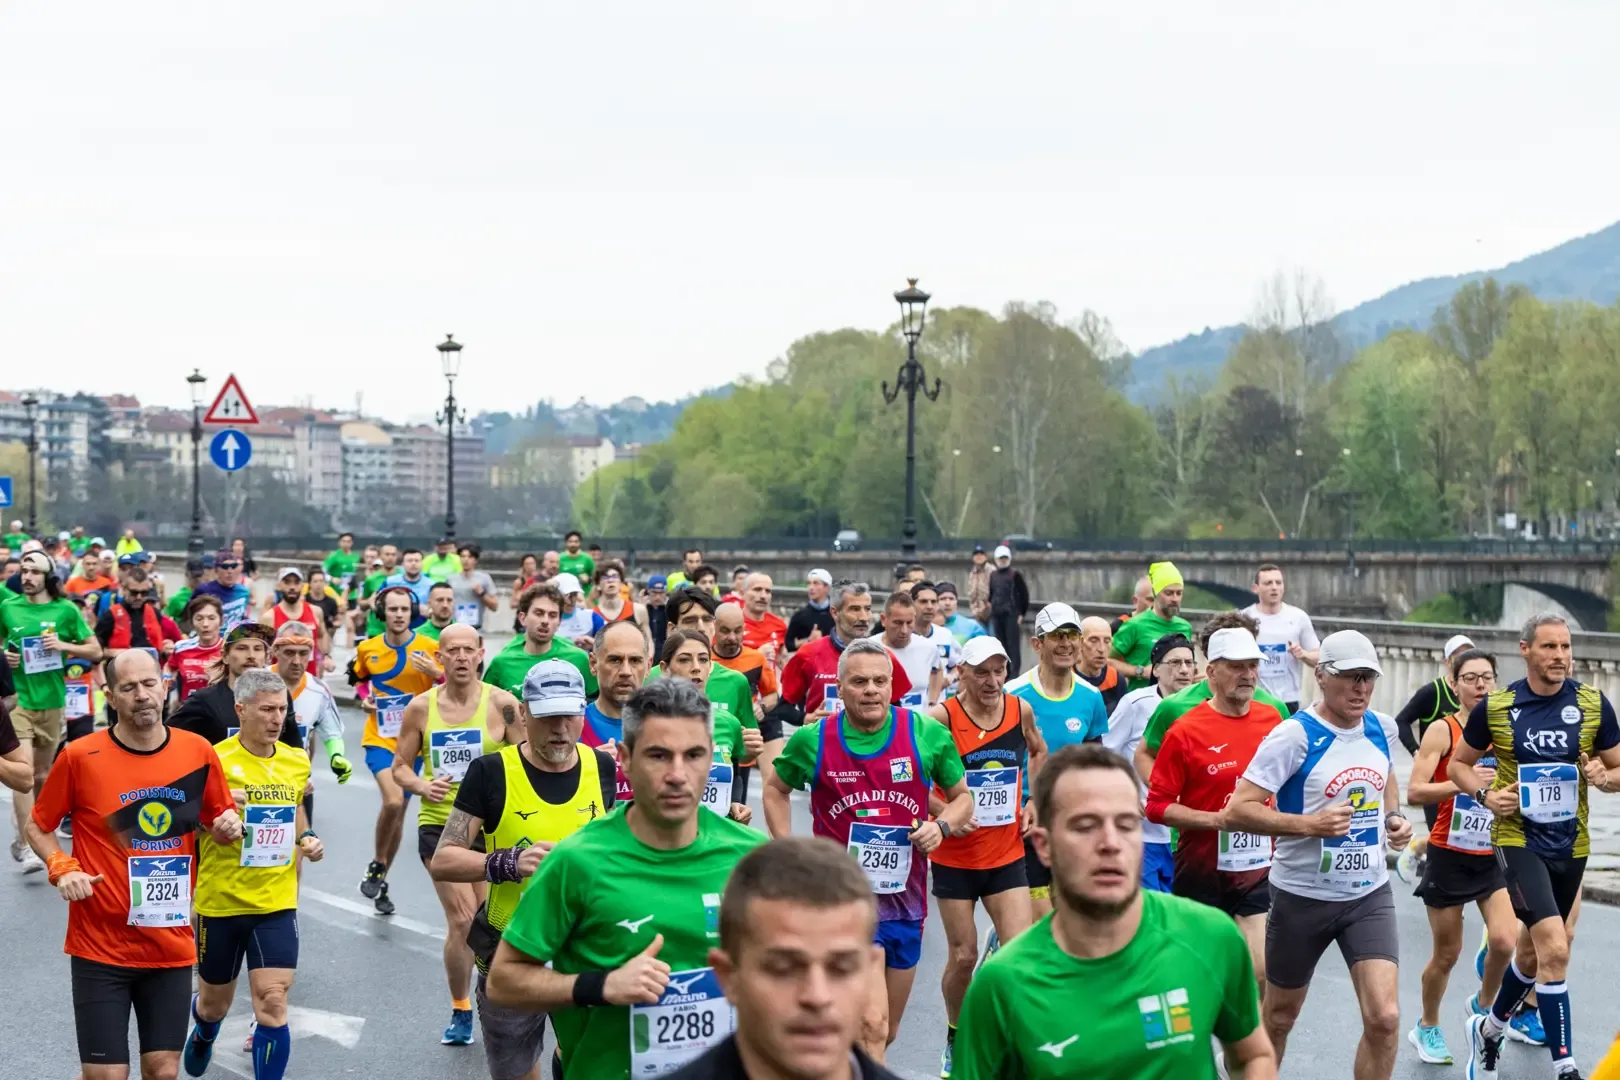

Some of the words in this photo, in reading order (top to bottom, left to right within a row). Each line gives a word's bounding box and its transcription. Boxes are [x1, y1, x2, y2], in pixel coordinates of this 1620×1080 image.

[442, 749, 472, 764] 2849
[966, 749, 1017, 764] PODISTICA
[244, 784, 295, 792] POLISPORTIVA
[1326, 768, 1384, 796] TAPPOROSSO
[119, 786, 186, 805] PODISTICA
[246, 791, 295, 802] TORRILE
[978, 790, 1008, 807] 2798
[1539, 785, 1561, 803] 178
[828, 791, 871, 820] POLIZIA
[871, 790, 886, 801] DI
[888, 790, 920, 815] STATO
[131, 837, 183, 852] TORINO
[256, 828, 285, 845] 3727
[862, 850, 899, 869] 2349
[1335, 853, 1369, 871] 2390
[146, 882, 179, 901] 2324
[673, 1004, 698, 1012] FABIO
[656, 1009, 715, 1044] 2288
